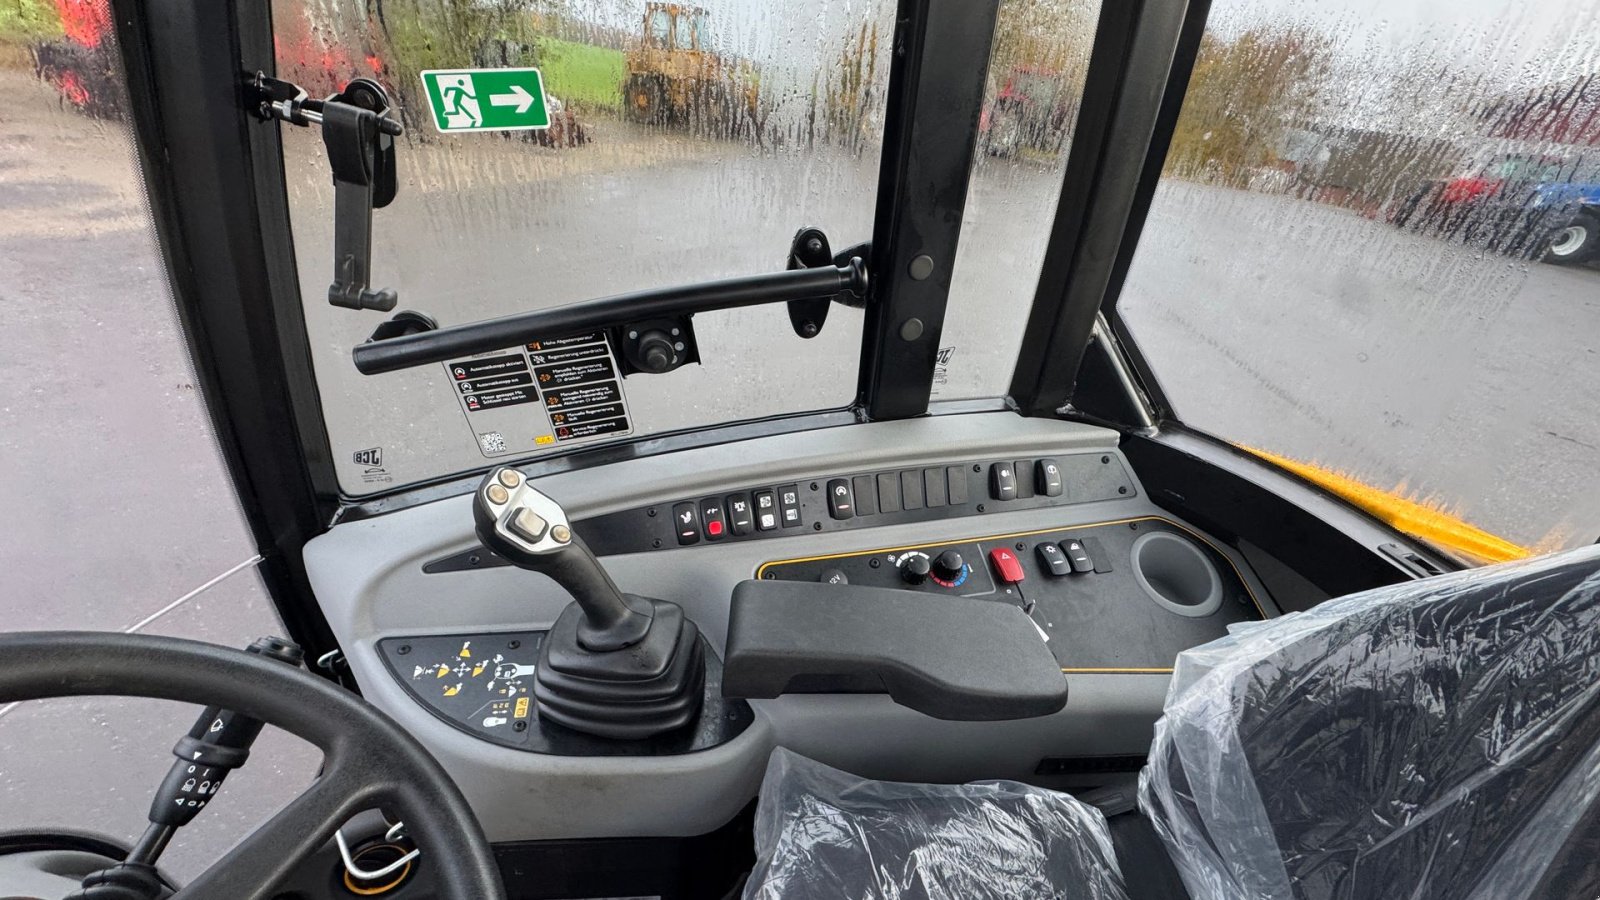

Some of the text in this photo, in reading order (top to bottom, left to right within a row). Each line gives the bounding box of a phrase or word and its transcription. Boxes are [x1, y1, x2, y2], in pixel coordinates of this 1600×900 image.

[547, 352, 579, 361] Regenerierung
[572, 363, 603, 372] Regenerierung
[579, 386, 609, 394] Regenerierung
[586, 407, 615, 415] Regenerierung
